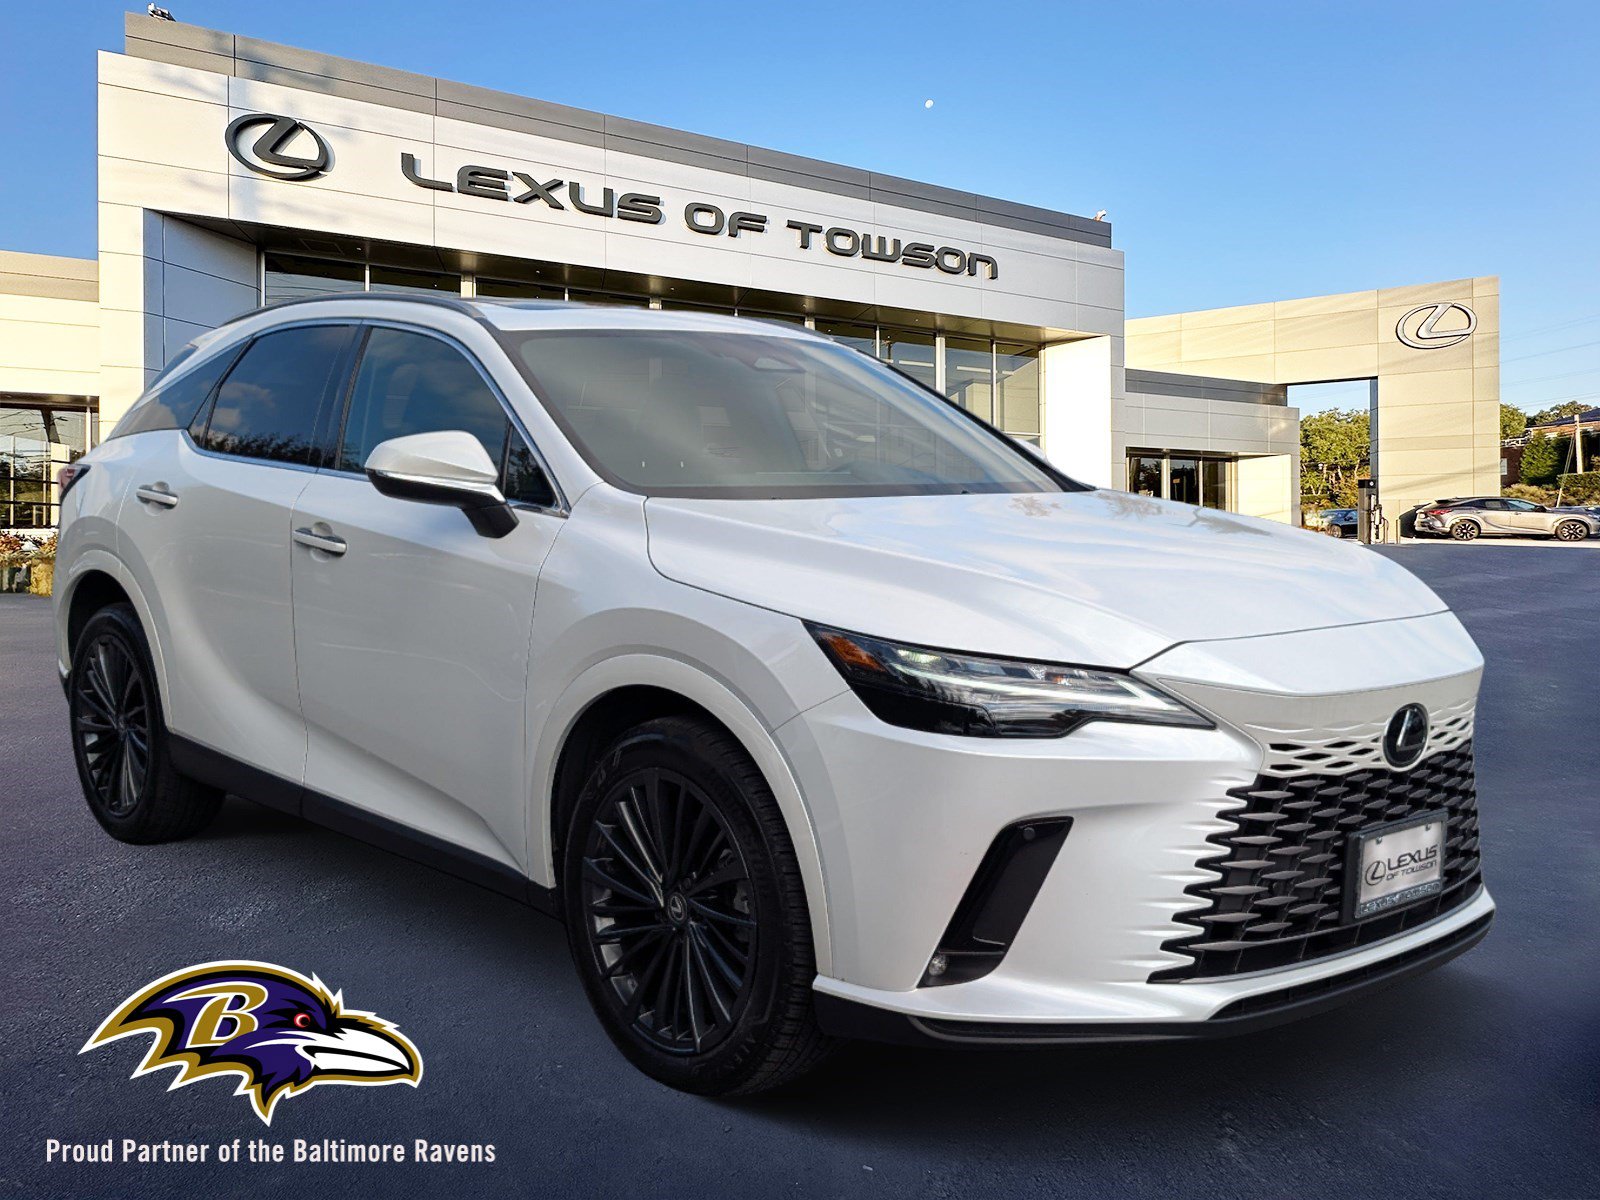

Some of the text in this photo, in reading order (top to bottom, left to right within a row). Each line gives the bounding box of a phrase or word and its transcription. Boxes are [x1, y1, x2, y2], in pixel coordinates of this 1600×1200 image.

[400, 152, 999, 280] LEXUS OF TOWSON
[1387, 844, 1438, 870] LEXUS
[1386, 860, 1437, 881] OF TOWSON
